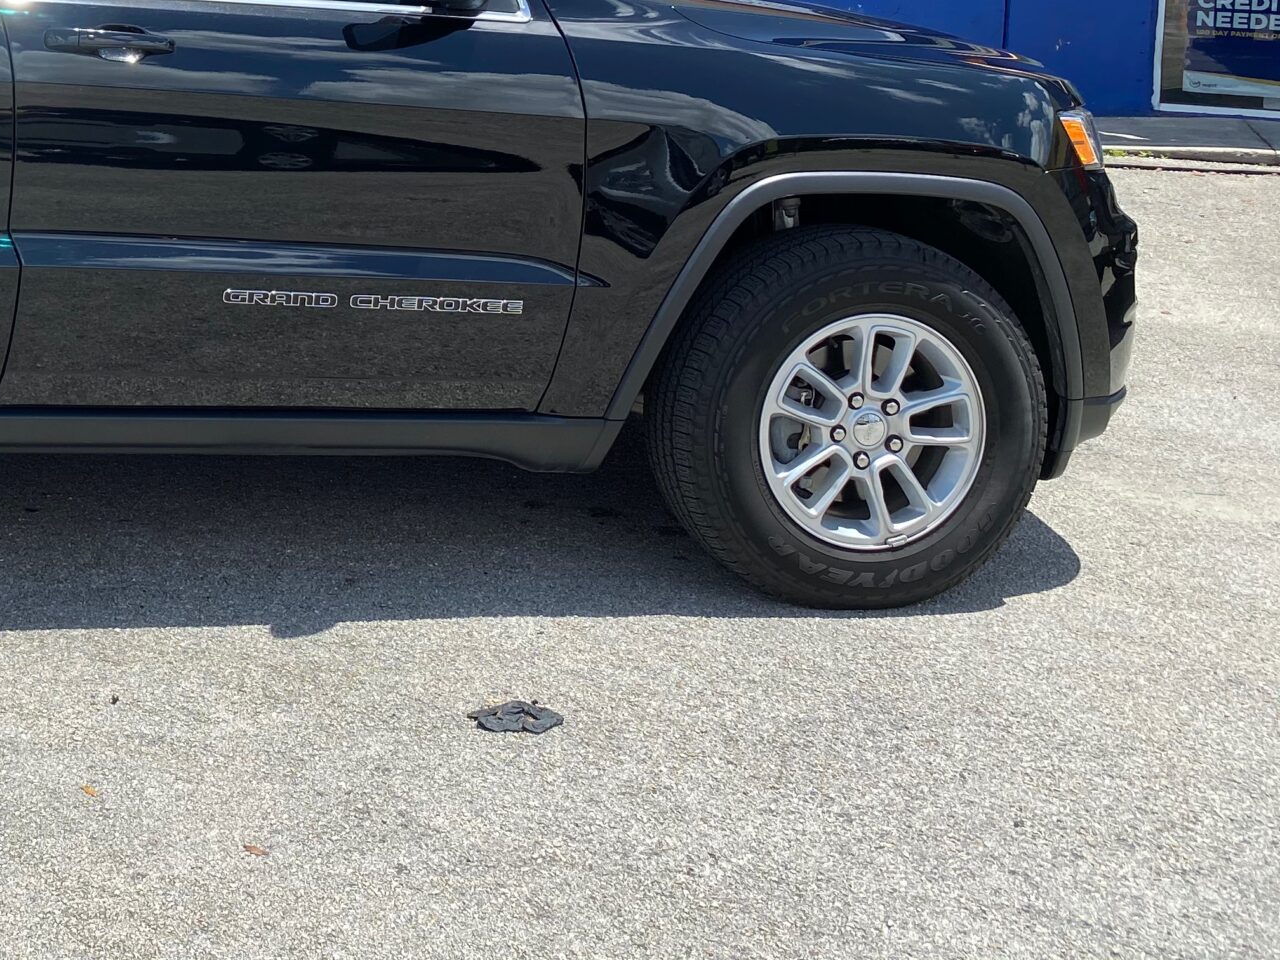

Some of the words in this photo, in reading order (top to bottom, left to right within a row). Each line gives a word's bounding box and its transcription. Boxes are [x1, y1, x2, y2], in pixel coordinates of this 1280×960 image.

[223, 289, 338, 309] GRAND
[349, 294, 524, 315] CHEROKEE
[768, 502, 995, 589] GOODYEAR
